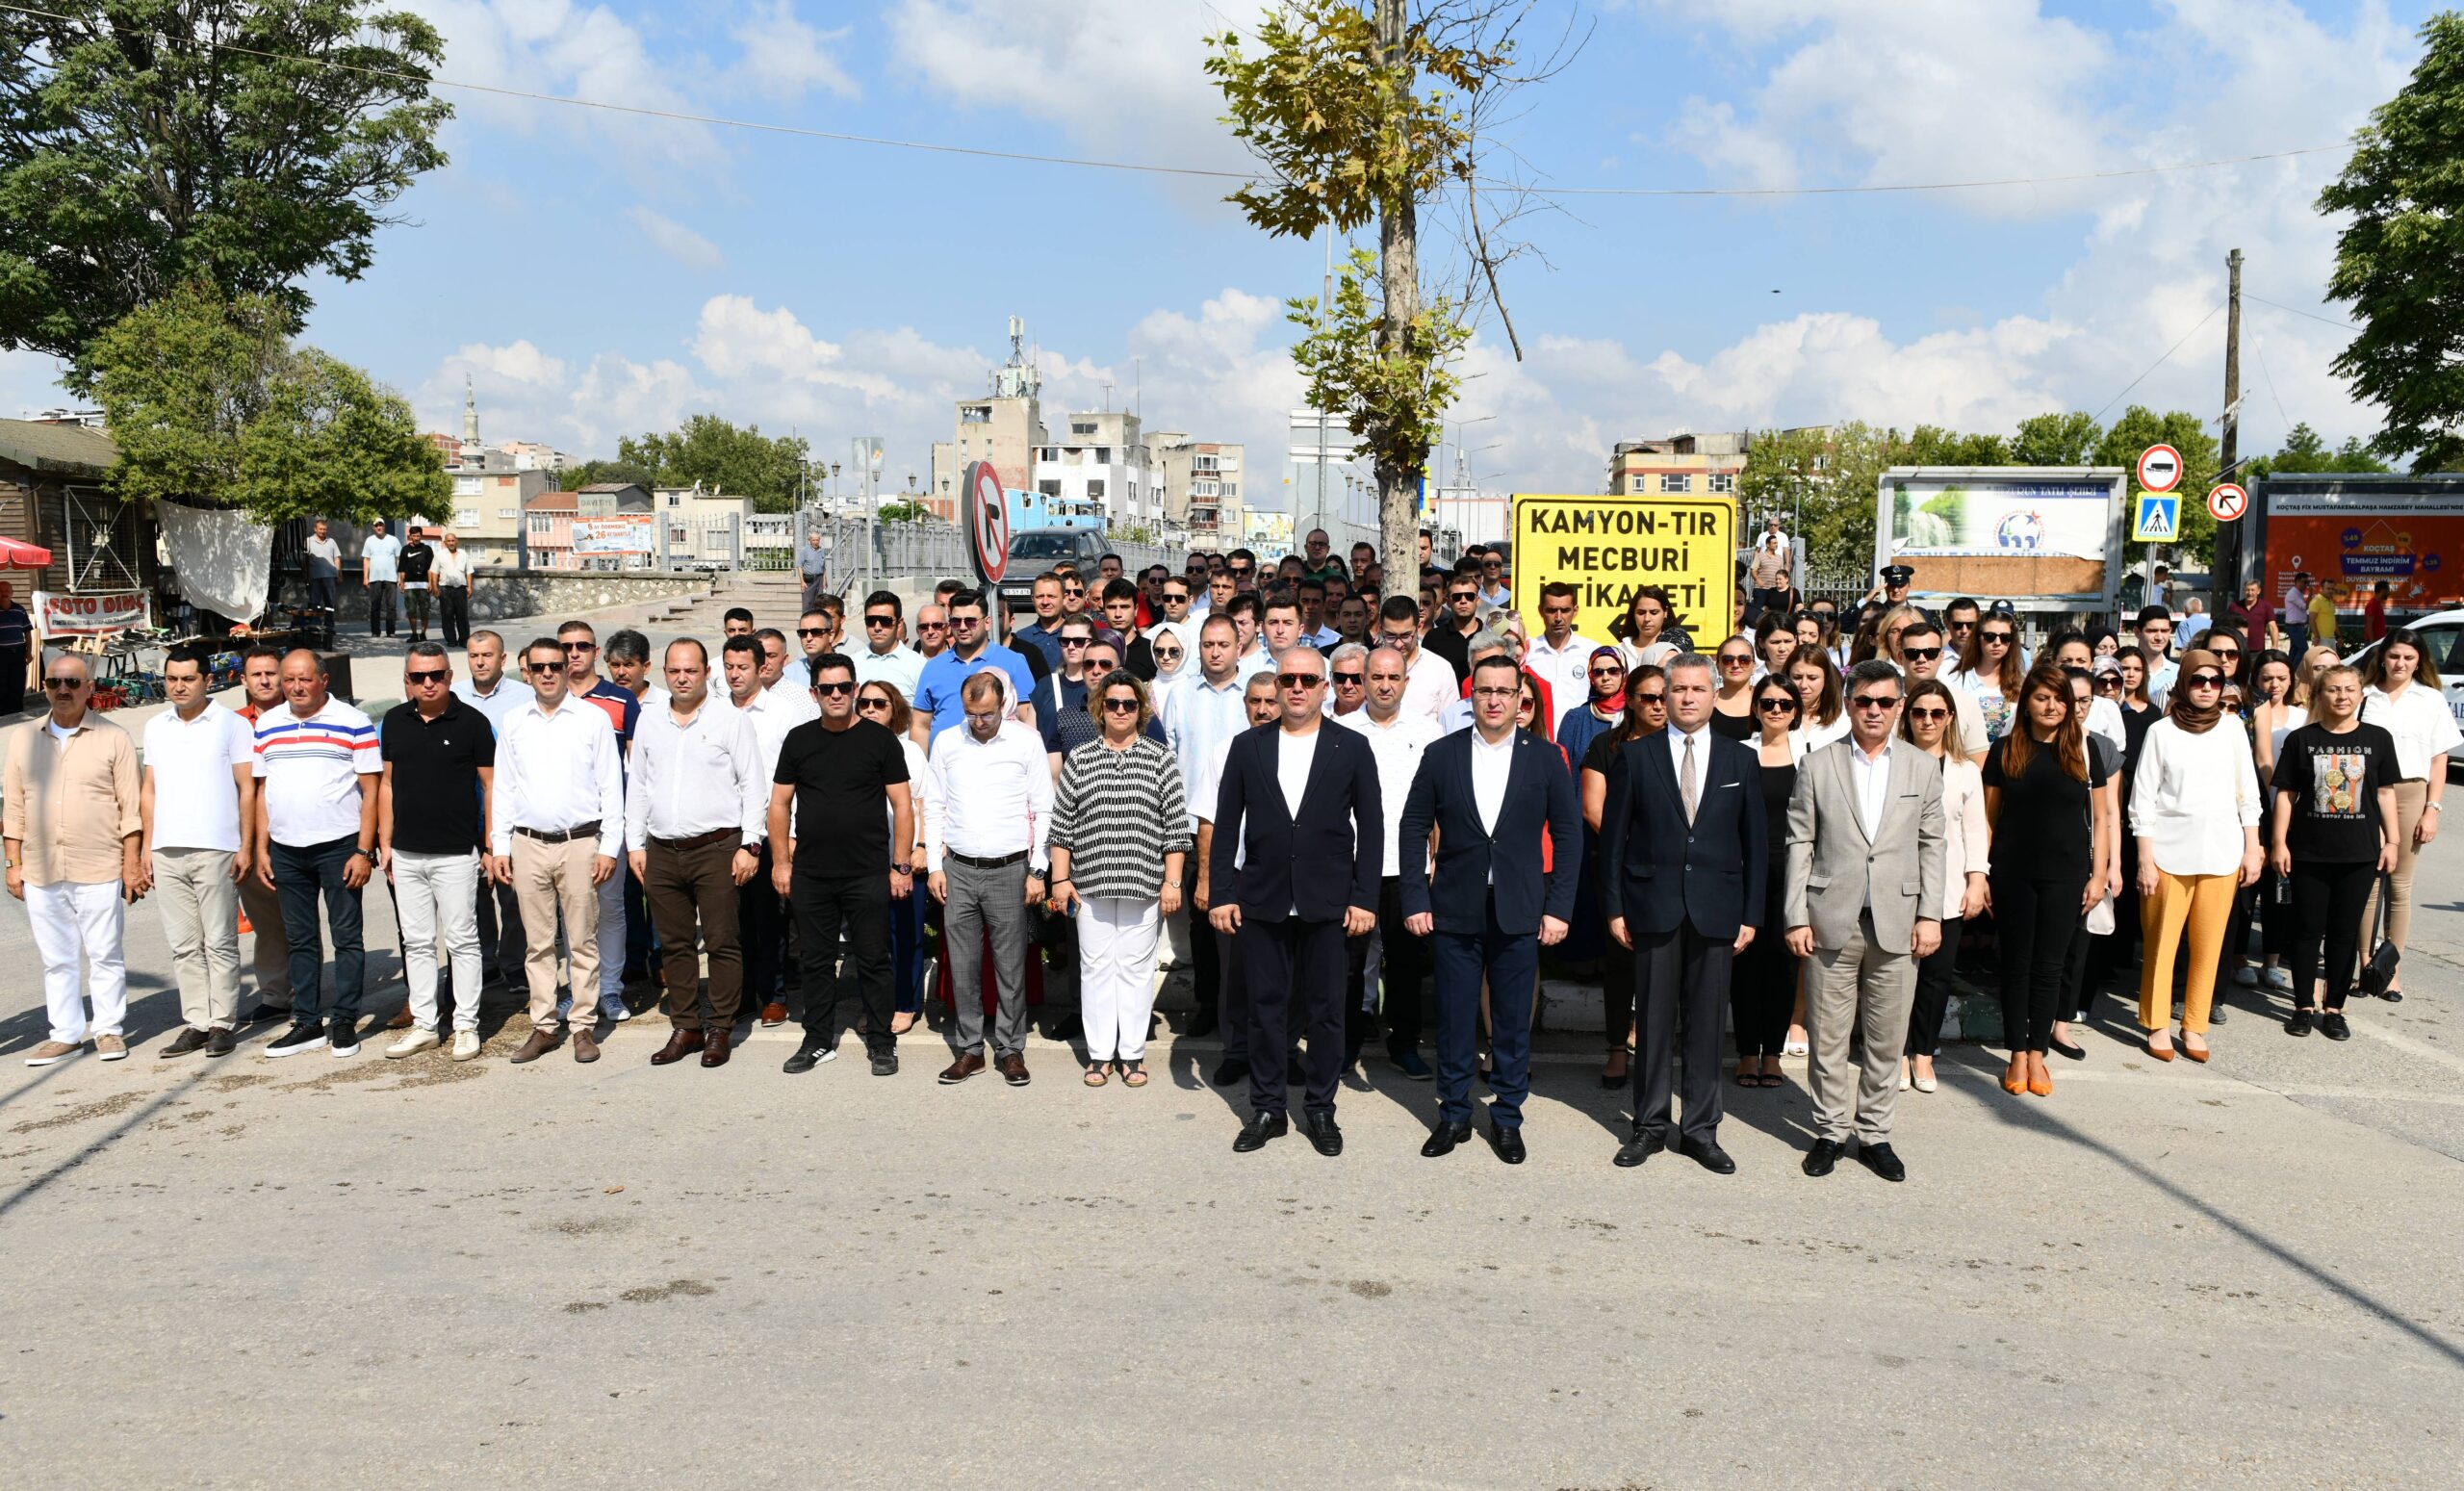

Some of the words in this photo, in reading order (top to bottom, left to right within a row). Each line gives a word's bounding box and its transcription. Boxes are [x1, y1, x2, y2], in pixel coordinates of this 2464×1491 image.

[2040, 486, 2065, 496] TATLI
[2066, 484, 2097, 499] ŞEHRİ
[1530, 508, 1717, 536] KAMYON-TIR
[1557, 541, 1689, 572] MECBURİ
[2363, 545, 2396, 553] KOÇTAŞ
[2379, 555, 2410, 565] İNDİRİM
[49, 597, 98, 615] FOTO
[2307, 745, 2373, 756] FASHION
